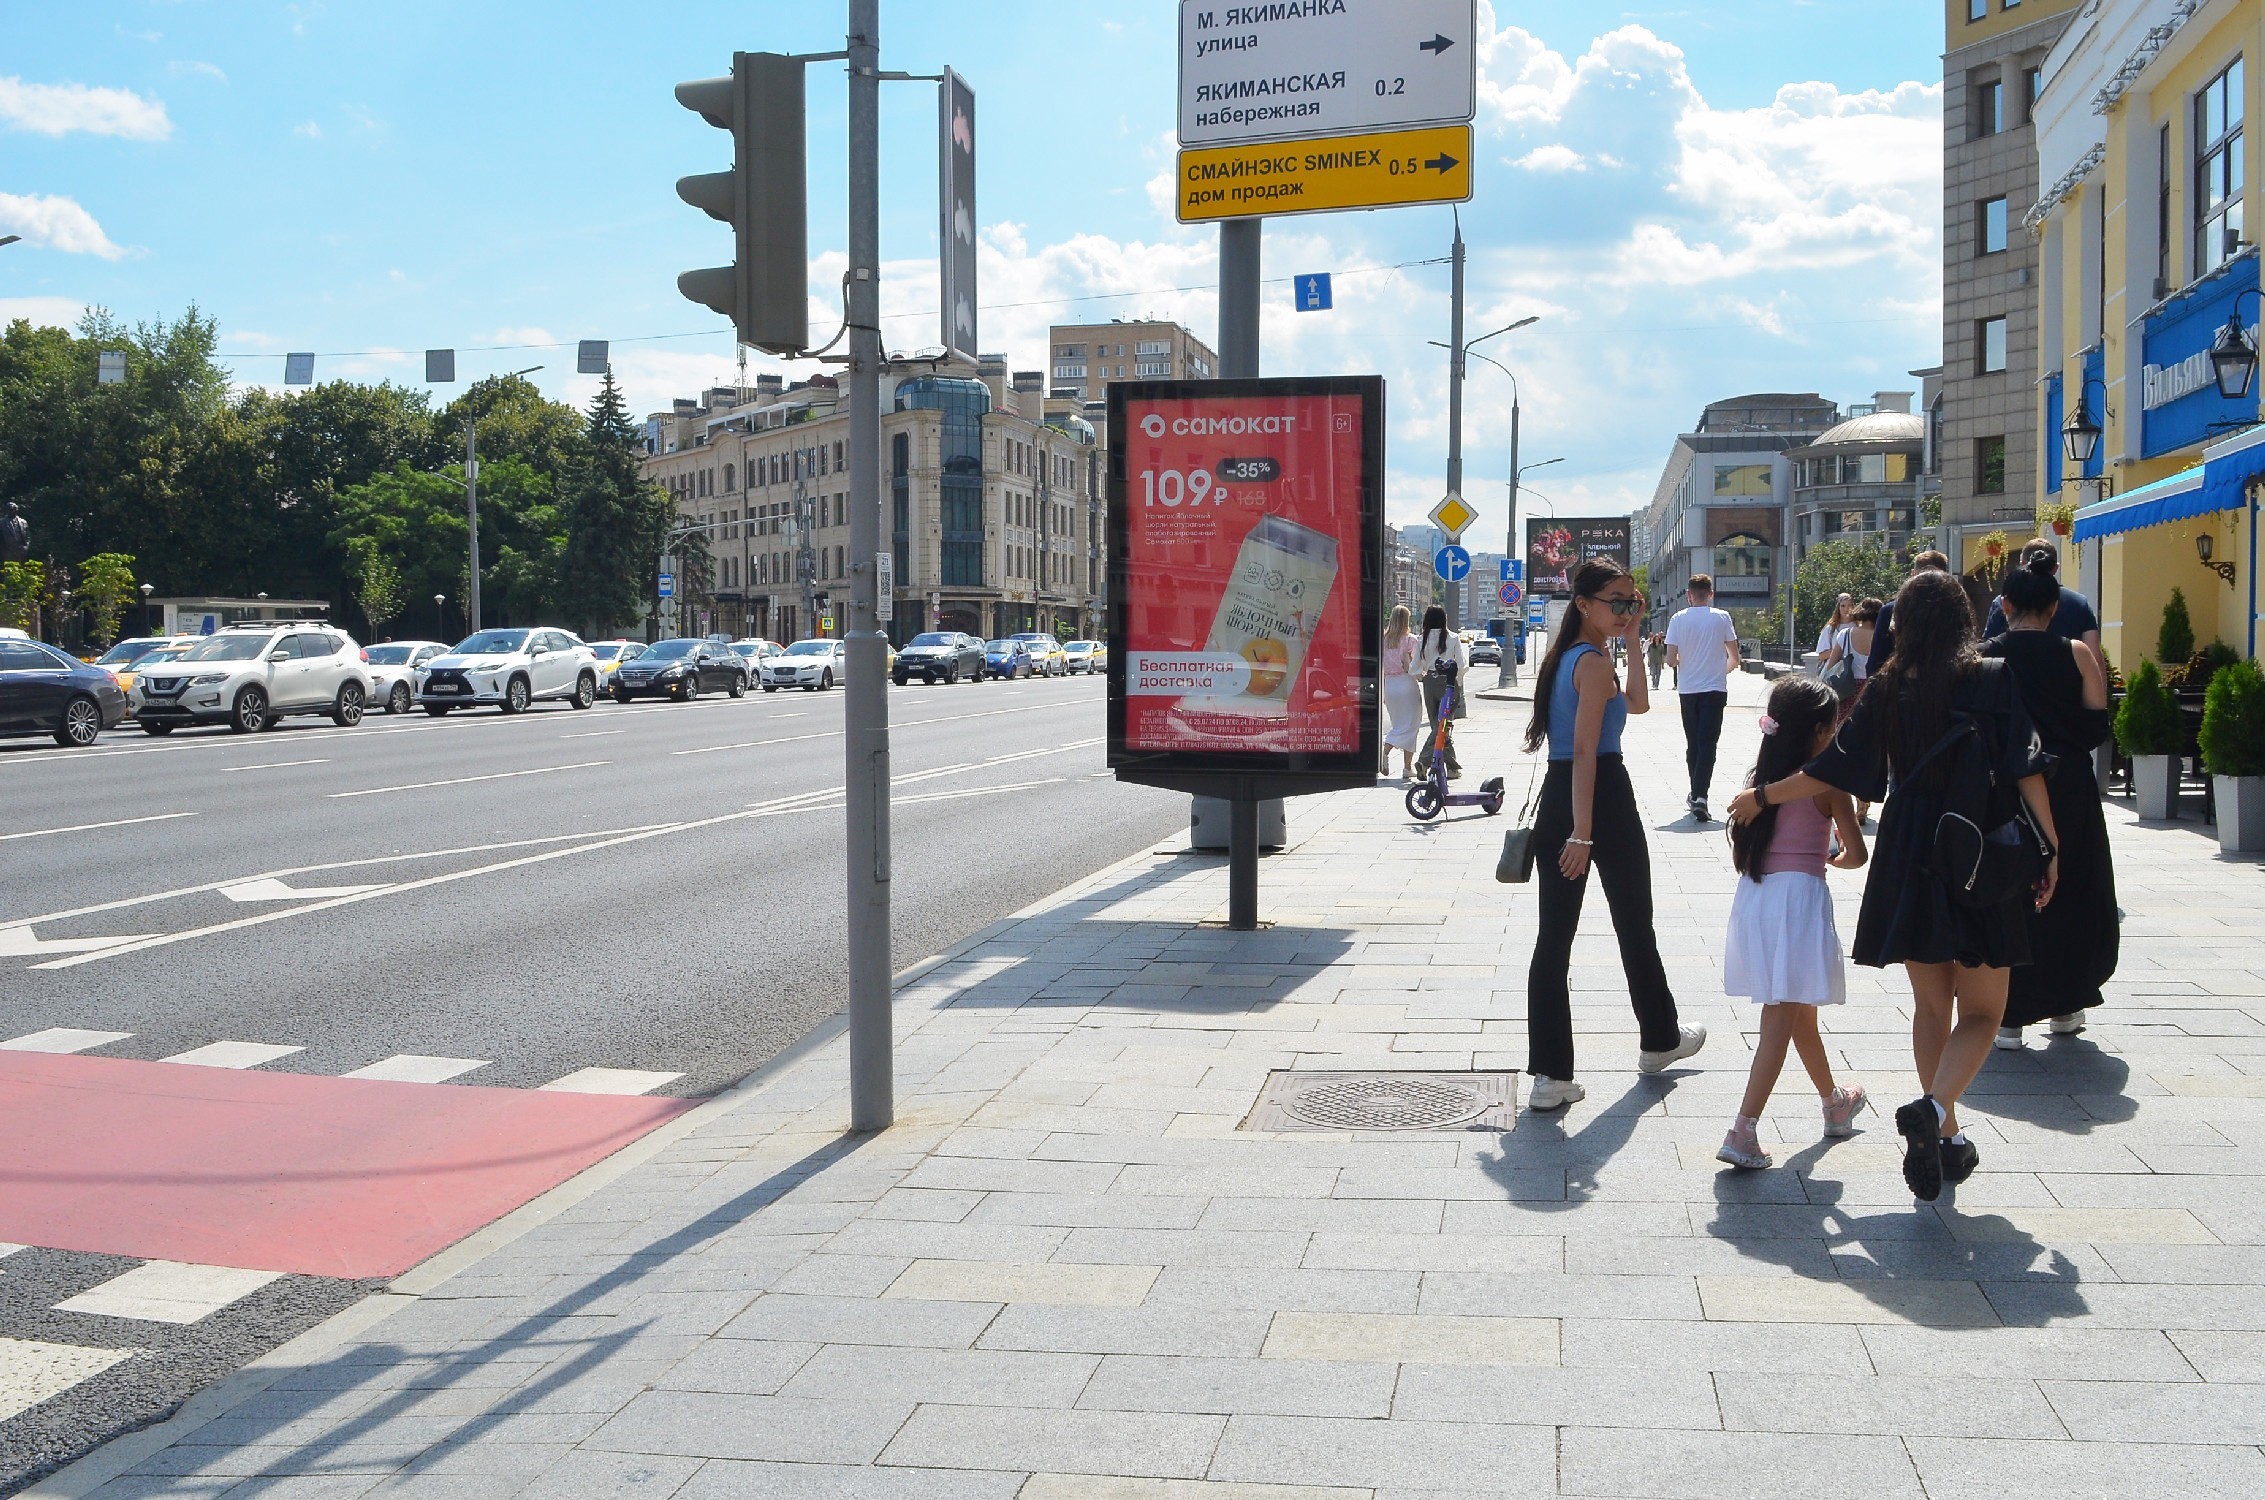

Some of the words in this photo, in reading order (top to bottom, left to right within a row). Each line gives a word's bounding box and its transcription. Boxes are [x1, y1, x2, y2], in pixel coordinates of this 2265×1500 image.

[1198, 12, 1219, 29] М.
[1226, 0, 1346, 26] ЯКИМАНКА
[1197, 32, 1258, 57] улица
[1196, 71, 1346, 102] ЯКИМАНСКАЯ
[1375, 78, 1405, 96] 0.2
[1196, 102, 1320, 126] набережная
[1187, 156, 1298, 181] СМАЙНЭКС
[1304, 149, 1381, 171] SMINEX
[1389, 158, 1417, 175] 0.5
[1187, 188, 1225, 206] дом
[1231, 182, 1304, 203] продаж
[1172, 416, 1296, 435] самокат
[1336, 418, 1348, 429] 6+
[1236, 490, 1266, 506] 168
[1139, 659, 1234, 673] Бесплатная
[1139, 676, 1212, 688] доставка
